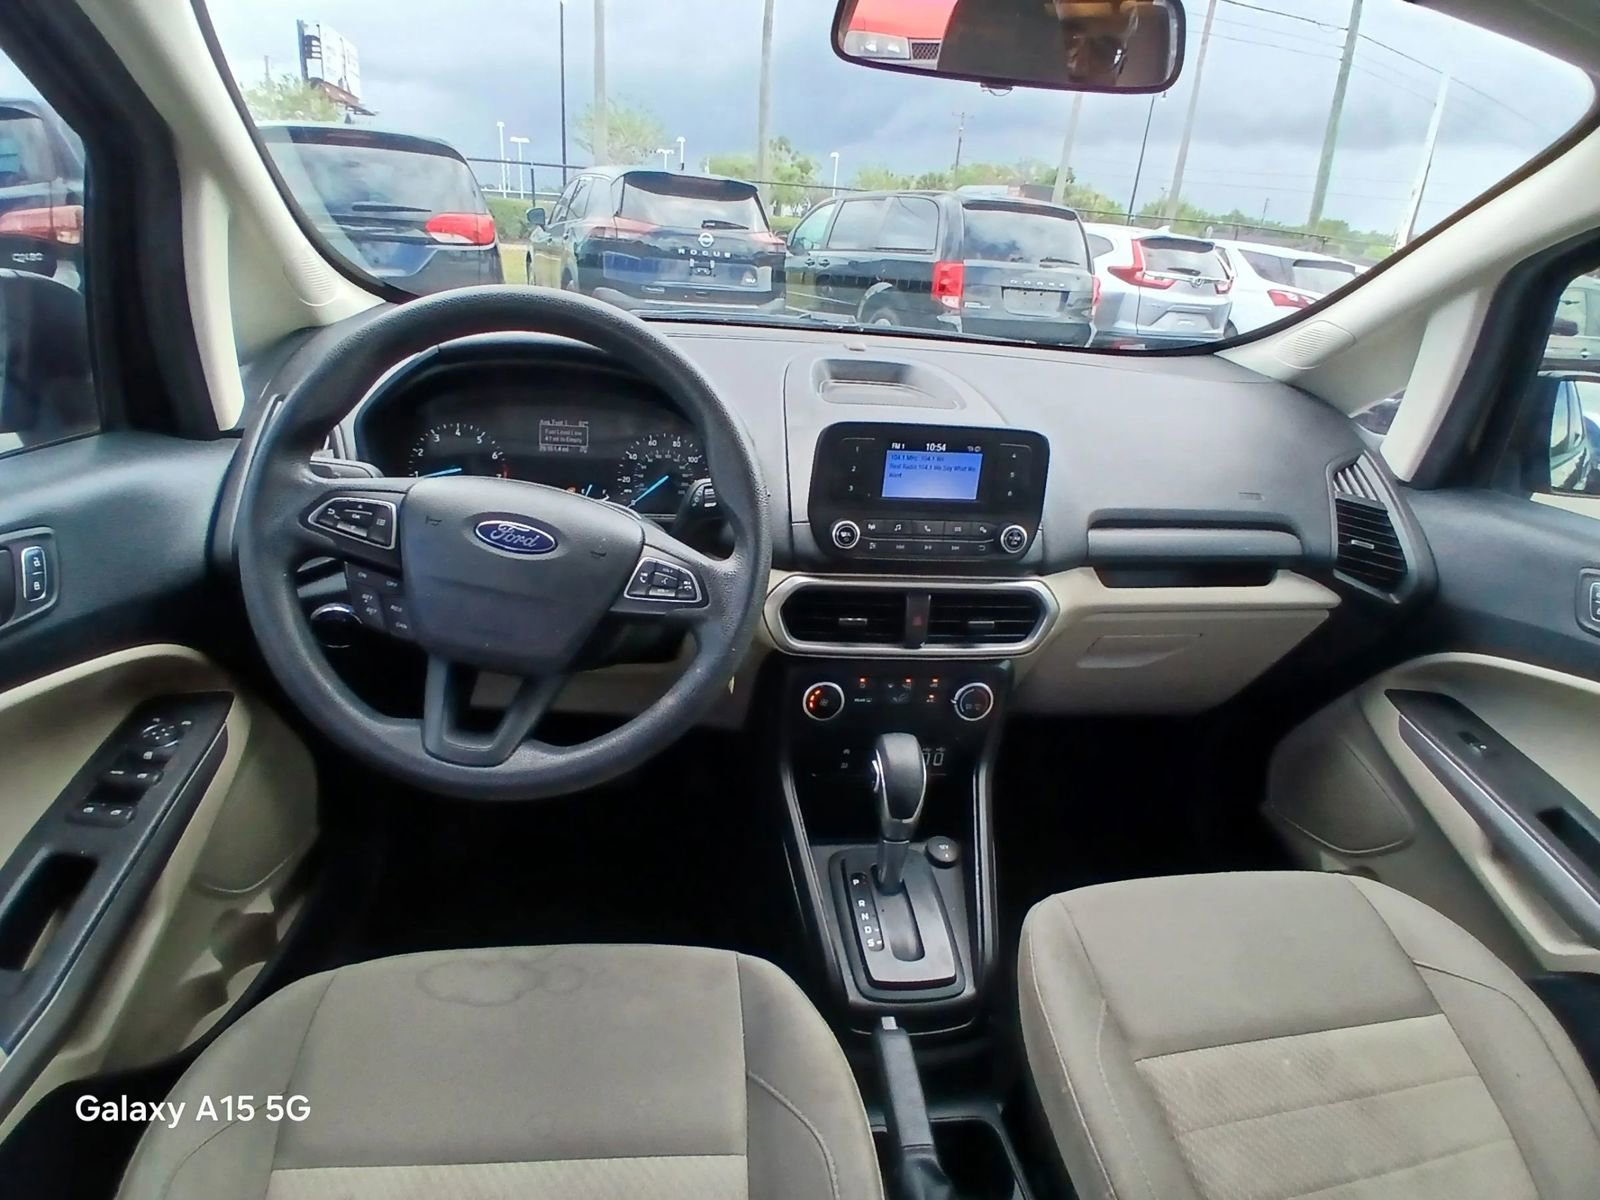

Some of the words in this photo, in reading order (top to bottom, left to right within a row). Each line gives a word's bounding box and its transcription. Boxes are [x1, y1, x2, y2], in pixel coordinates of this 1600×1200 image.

[678, 248, 731, 258] ROGUE
[455, 428, 461, 436] 4
[434, 433, 440, 442] 3
[476, 435, 482, 444] 5
[648, 439, 657, 447] 60
[926, 442, 947, 452] 10:54
[418, 448, 424, 456] 2
[491, 452, 498, 460] 6
[628, 453, 638, 461] 40
[490, 523, 540, 548] Ford
[867, 939, 875, 947] S
